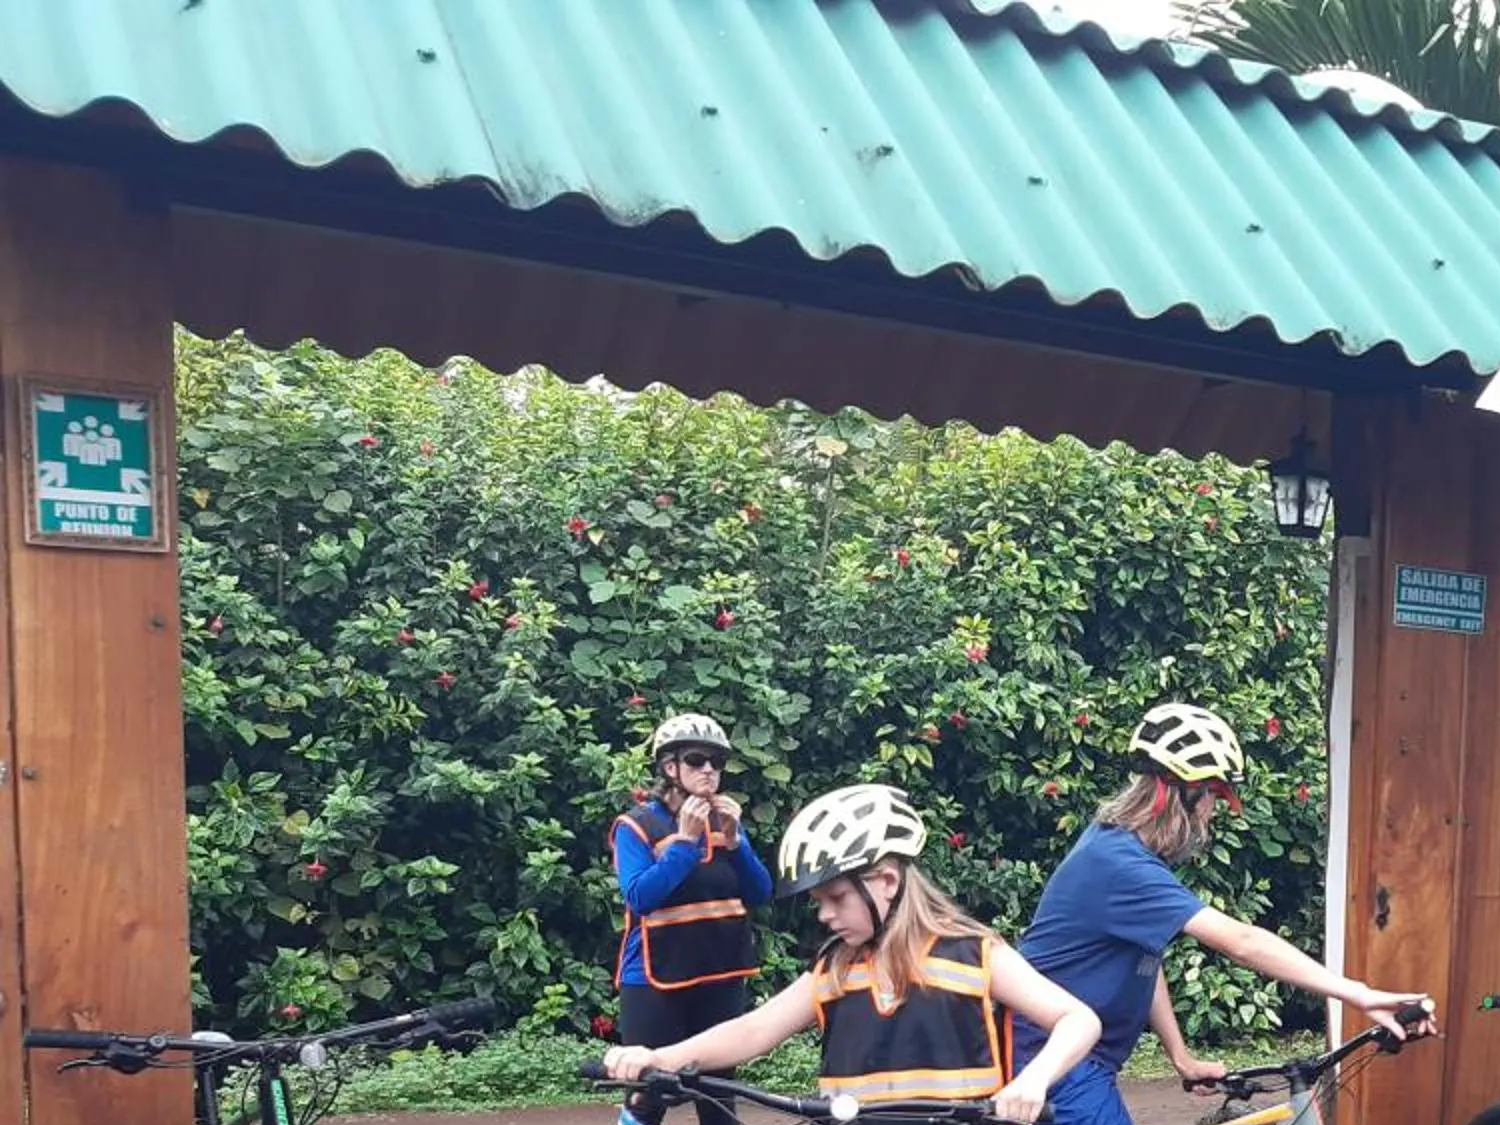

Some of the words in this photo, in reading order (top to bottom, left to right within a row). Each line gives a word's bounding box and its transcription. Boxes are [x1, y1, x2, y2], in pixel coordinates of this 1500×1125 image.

[54, 502, 109, 521] PUNTO
[116, 505, 137, 522] DE
[1401, 569, 1459, 590] SALIDA
[1462, 577, 1483, 592] DE
[1401, 586, 1480, 609] EMERGENCIA
